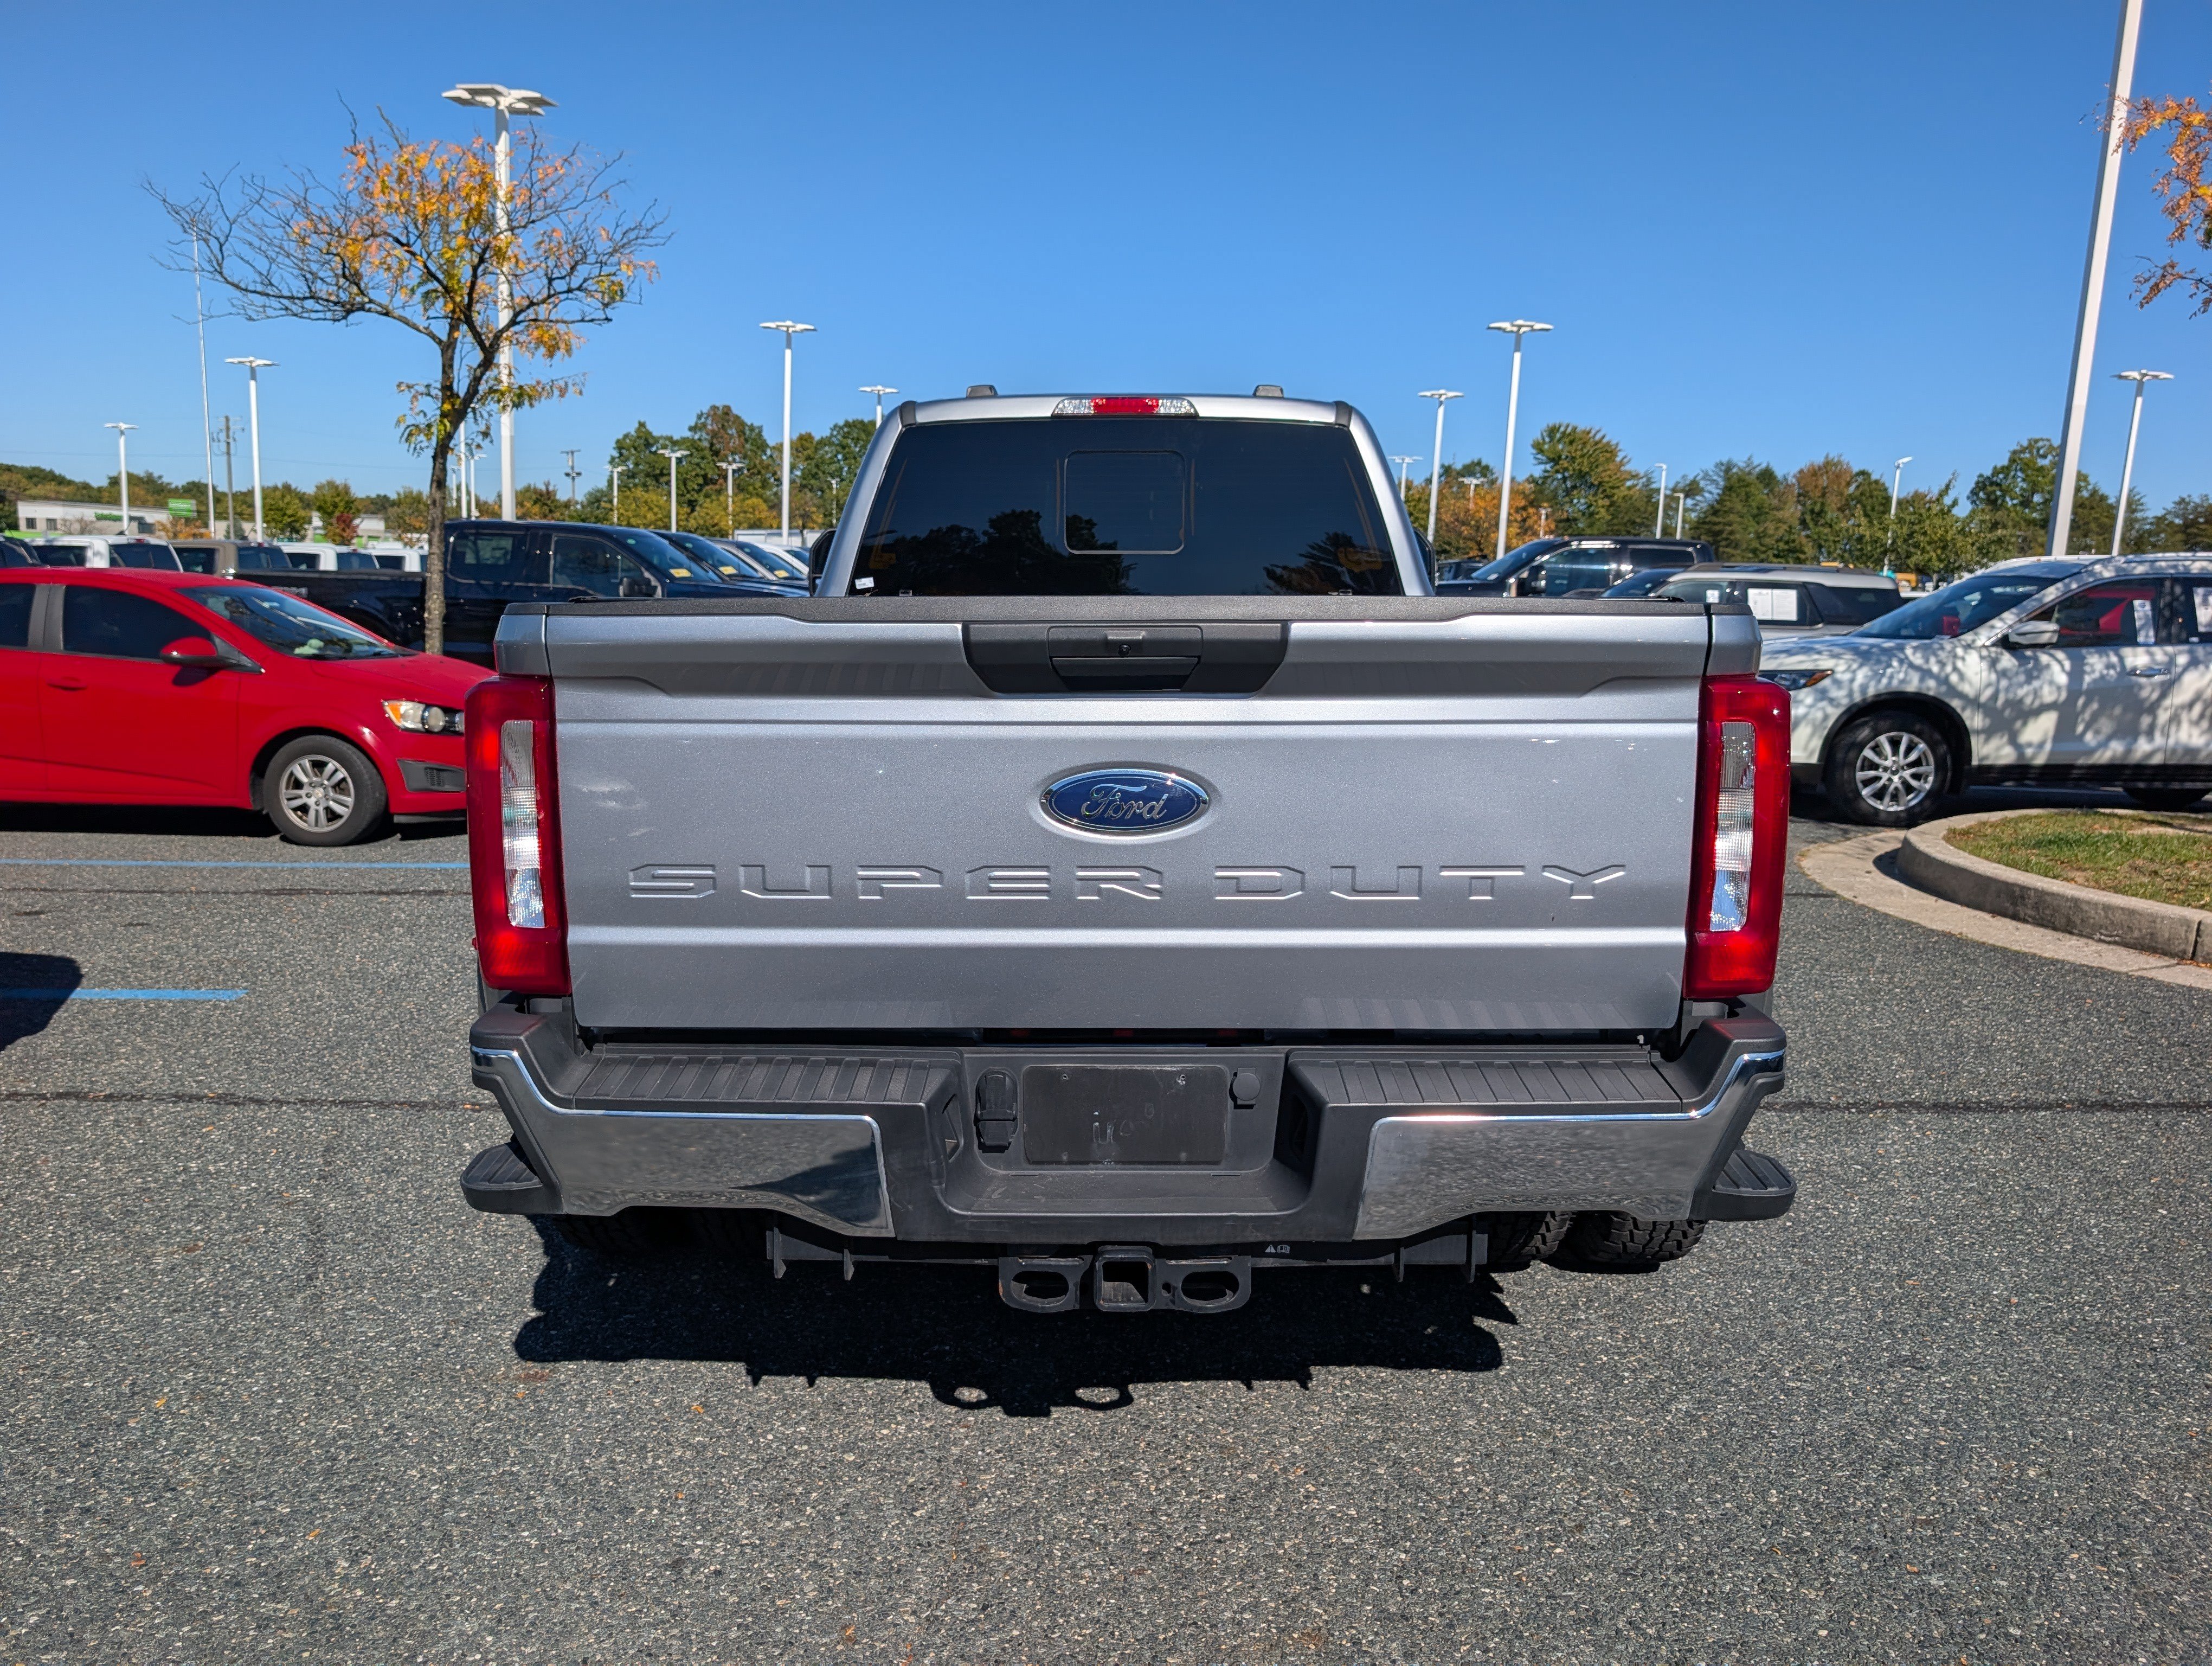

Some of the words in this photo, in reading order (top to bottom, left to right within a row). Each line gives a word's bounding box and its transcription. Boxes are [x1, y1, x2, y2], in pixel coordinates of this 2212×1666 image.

[1081, 783, 1169, 819] Ford
[628, 864, 1163, 901] SUPER
[1214, 864, 1626, 901] DUTY
